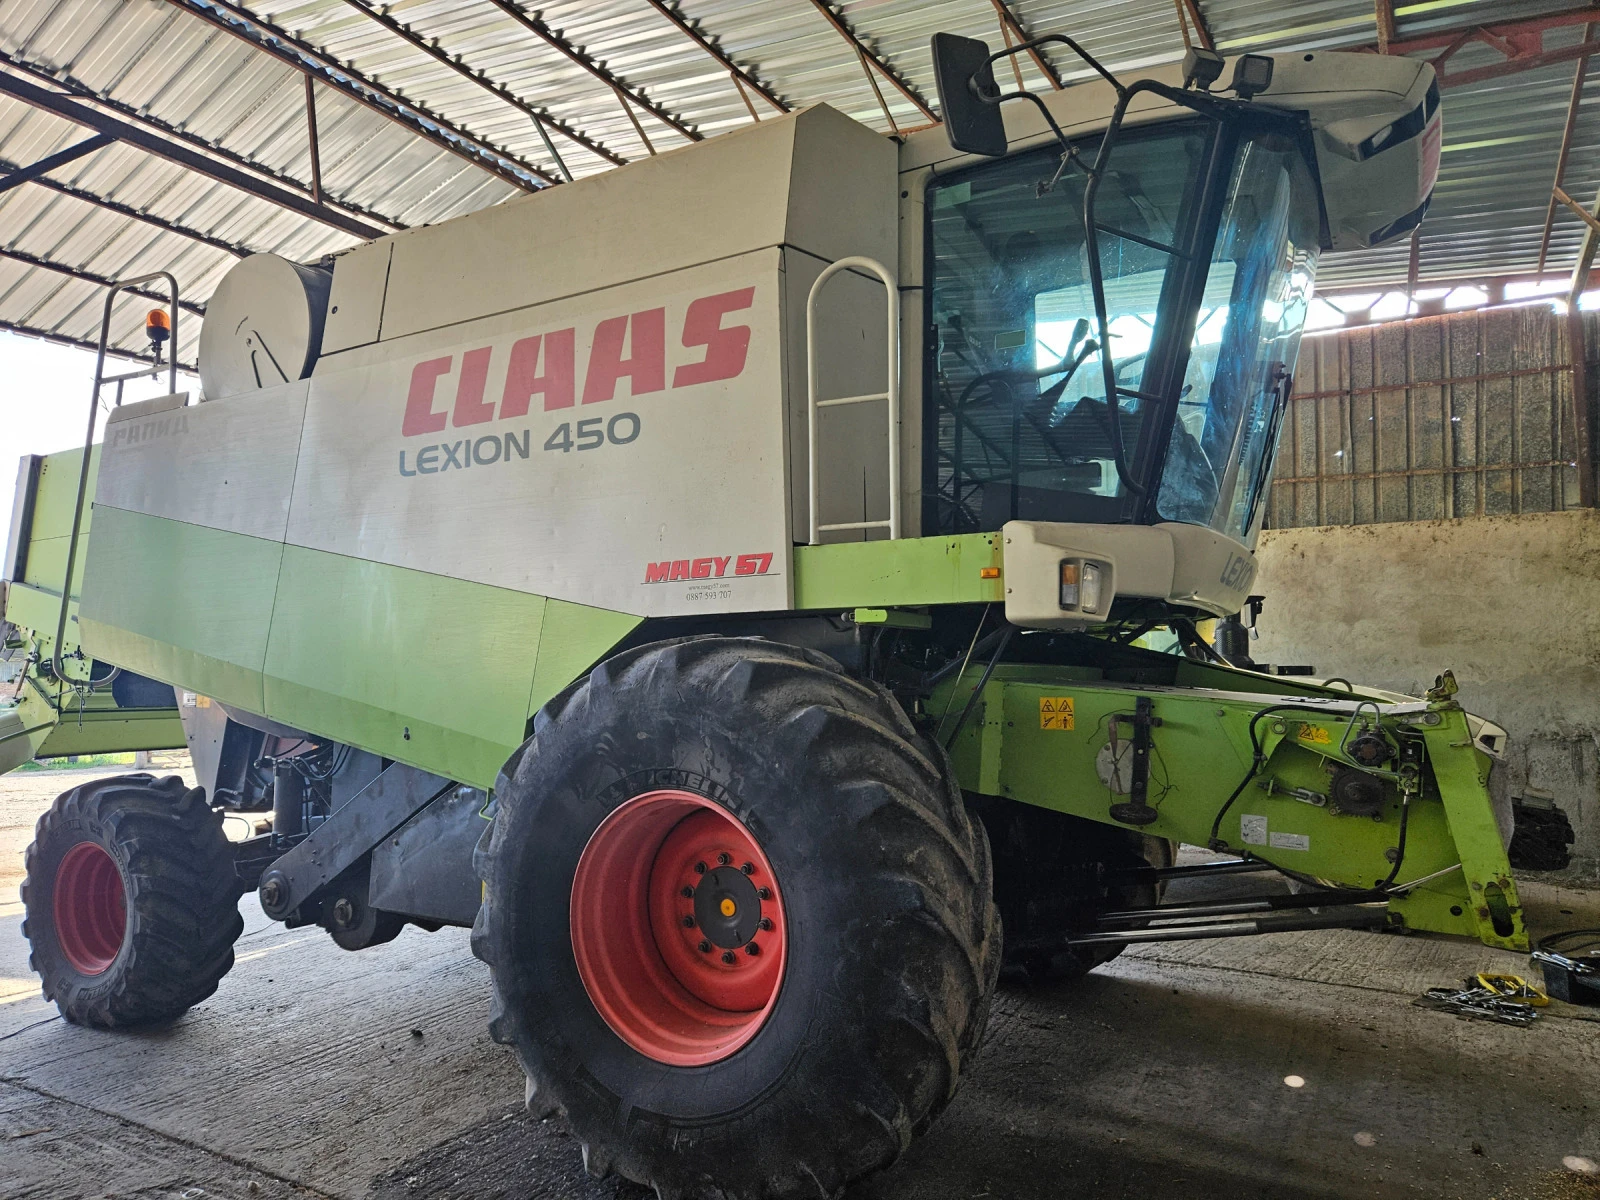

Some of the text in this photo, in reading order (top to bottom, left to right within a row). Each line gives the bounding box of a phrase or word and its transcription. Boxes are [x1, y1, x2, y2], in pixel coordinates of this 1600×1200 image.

[401, 285, 755, 437] CLAAS
[112, 414, 189, 448] РАПИД
[399, 412, 641, 477] LEXION 450
[645, 553, 774, 582] MAGY 57
[686, 590, 732, 601] 0887 593 707
